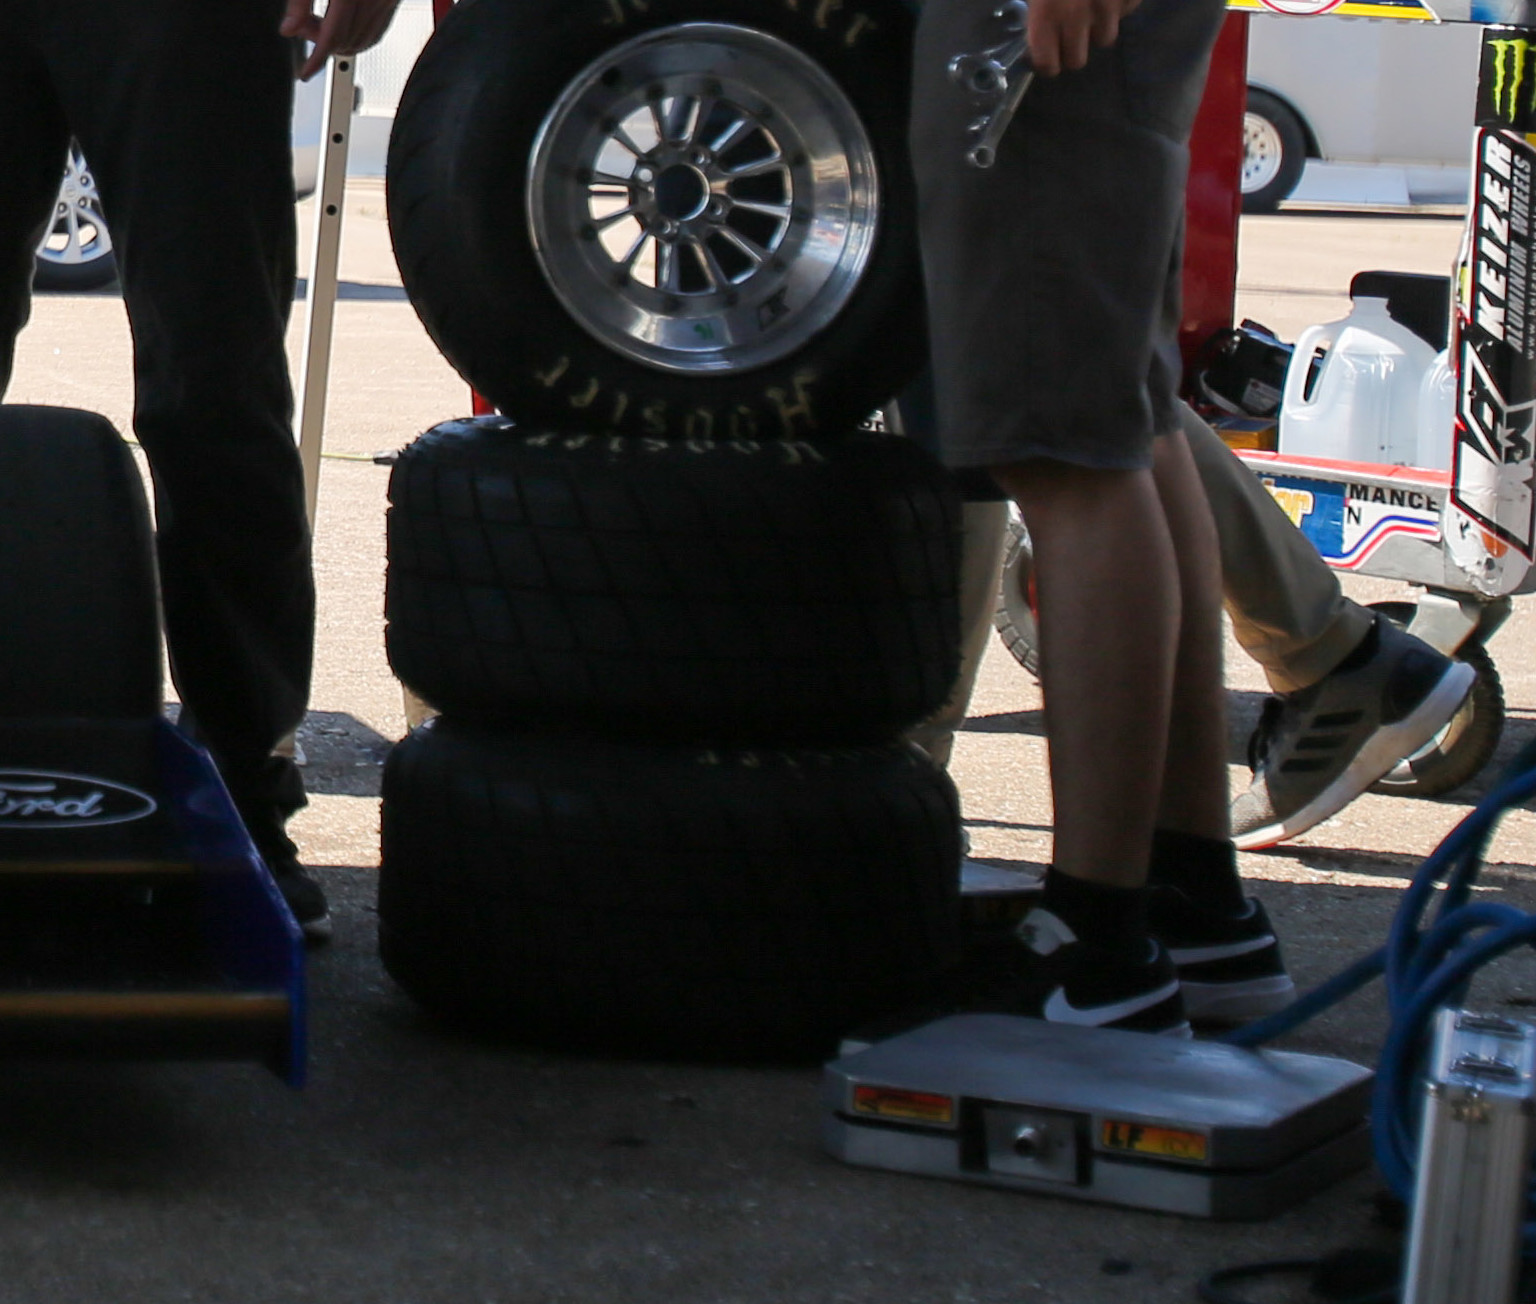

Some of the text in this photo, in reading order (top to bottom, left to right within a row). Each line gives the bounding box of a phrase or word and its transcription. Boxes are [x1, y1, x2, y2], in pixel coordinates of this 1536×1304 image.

[1477, 135, 1514, 342] KEIZER
[1506, 153, 1532, 353] ALUMINUM WHEELS
[1109, 1123, 1144, 1149] LF
